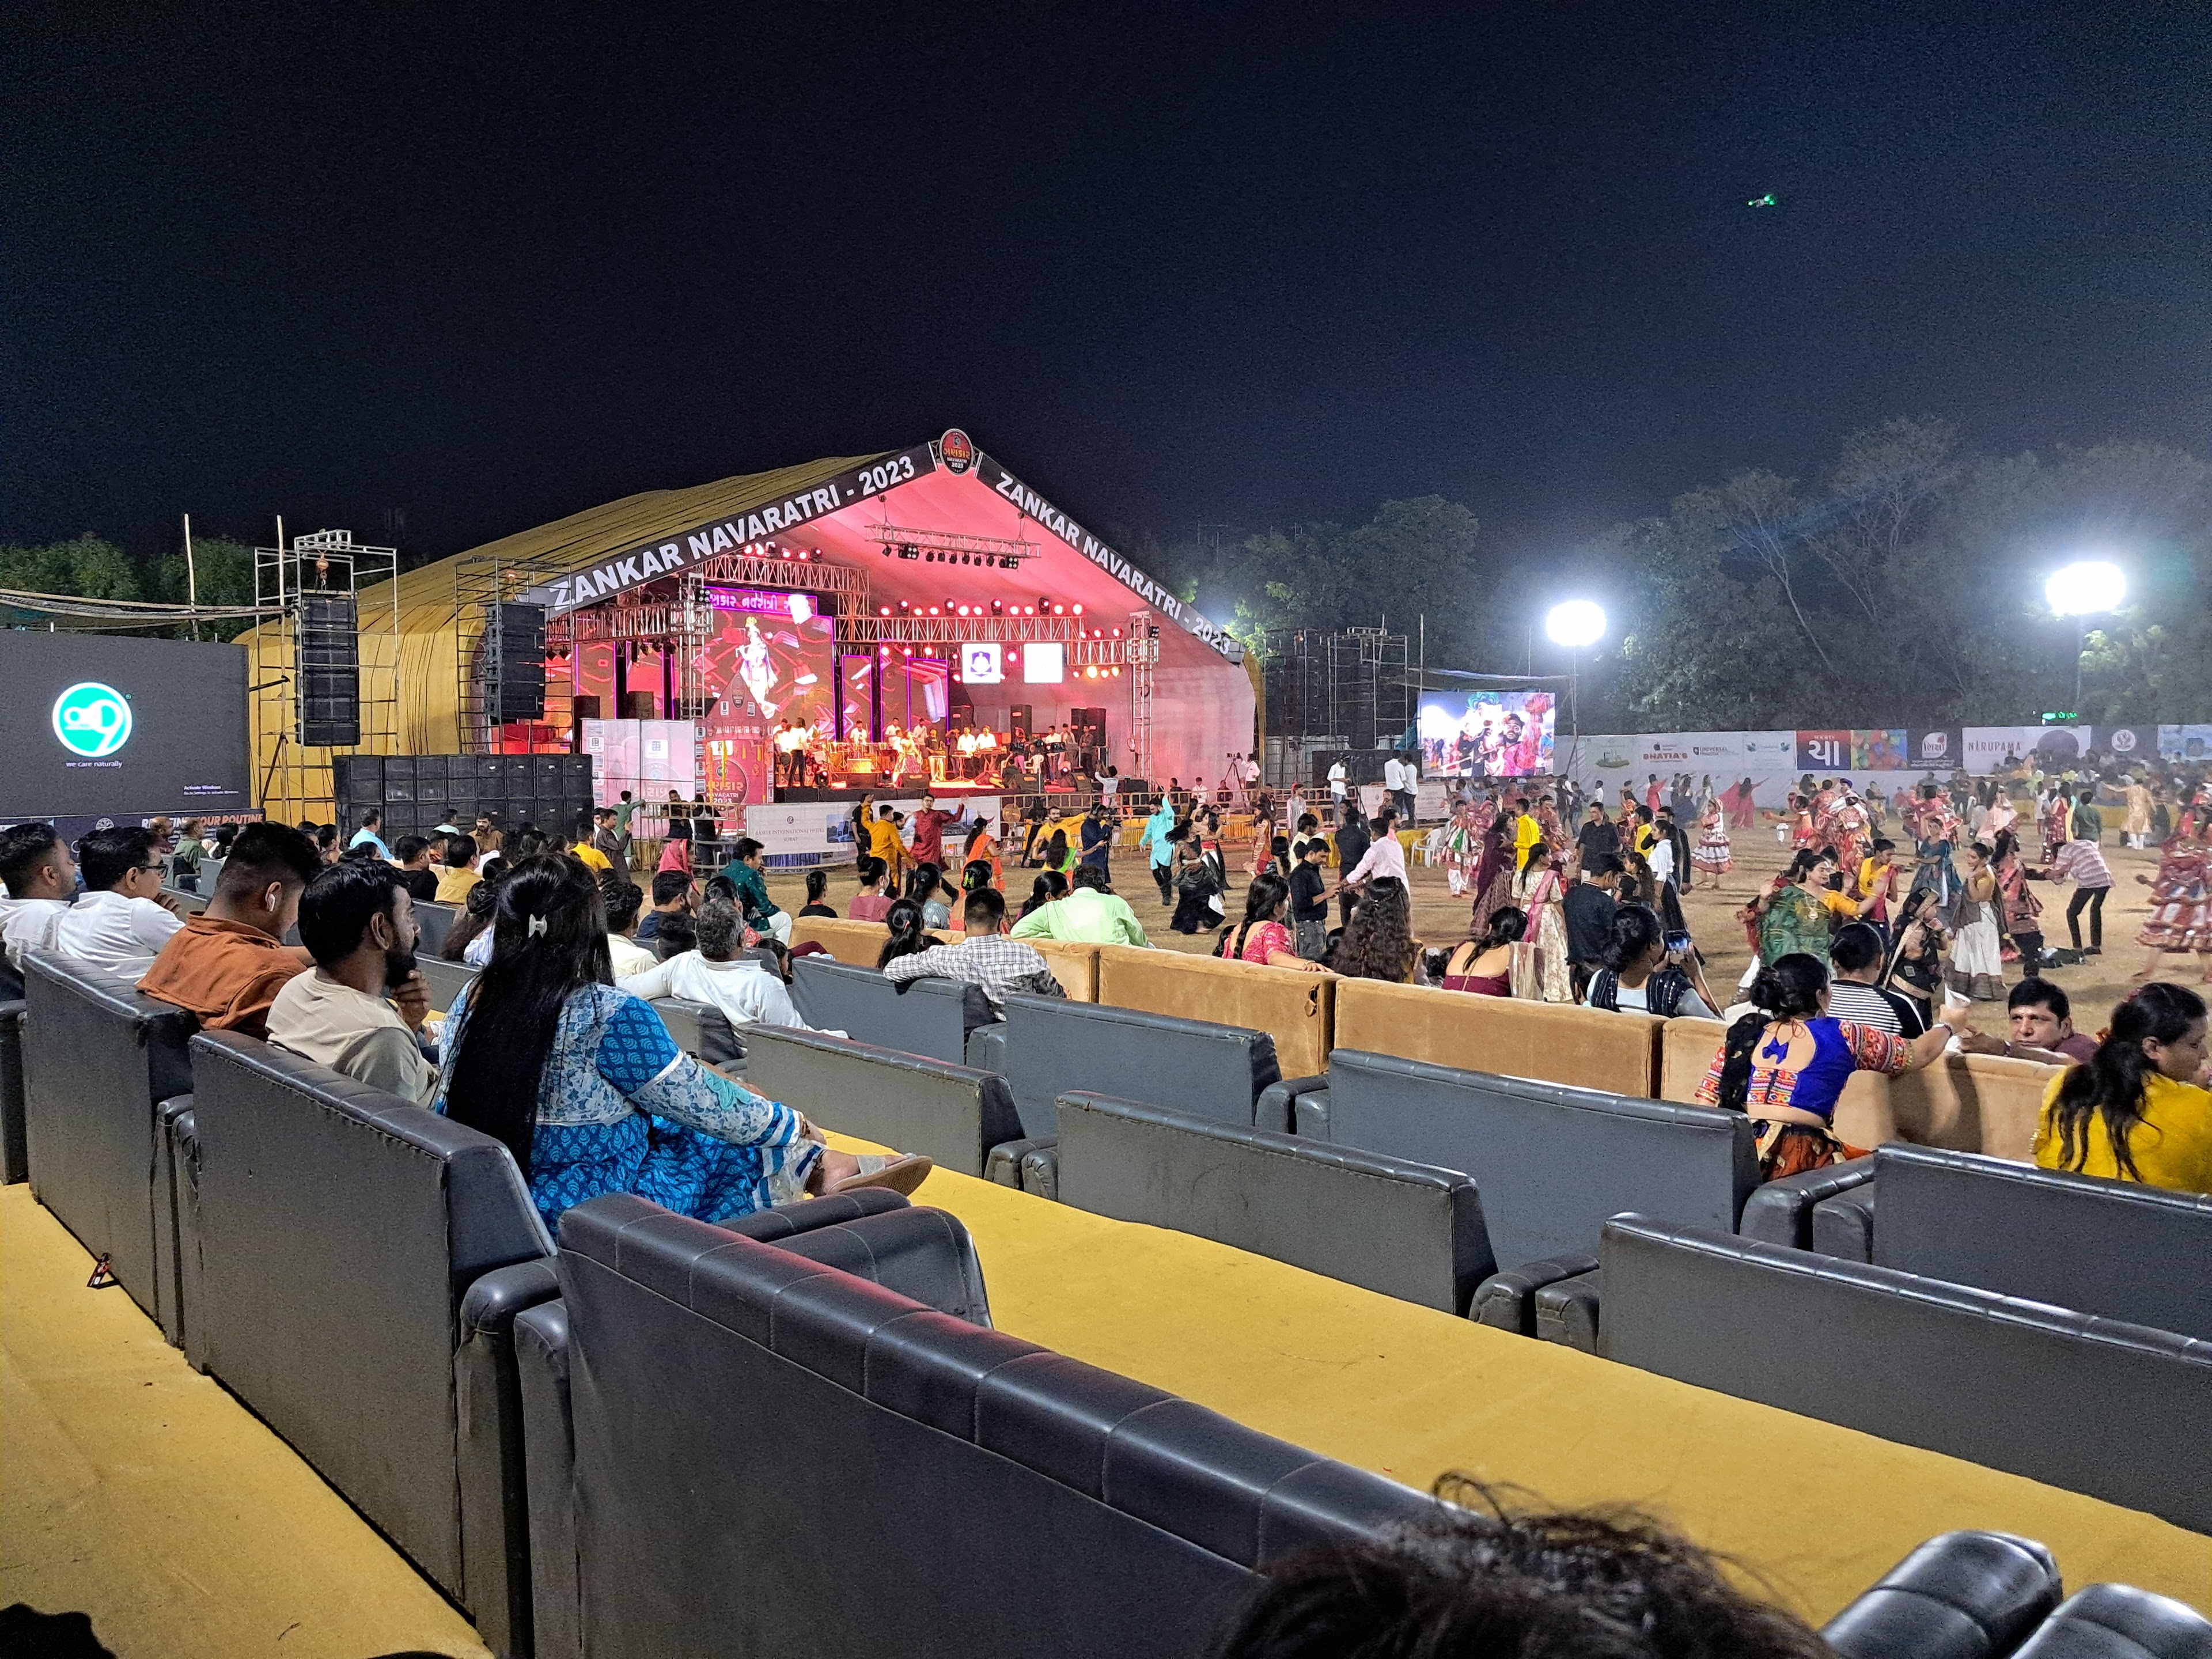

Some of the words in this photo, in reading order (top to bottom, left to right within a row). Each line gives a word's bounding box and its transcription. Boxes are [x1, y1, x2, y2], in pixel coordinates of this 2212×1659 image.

[549, 543, 685, 611] ZANKAR
[688, 484, 840, 560] NAVARATRI
[858, 456, 915, 495] 2023
[995, 471, 1080, 547] ZANKAR
[1083, 535, 1182, 620] NAVARATRI
[1192, 617, 1230, 654] 2023
[1968, 740, 2021, 752] NIRUPAMA
[93, 760, 123, 768] naturally
[200, 815, 222, 826] OUR
